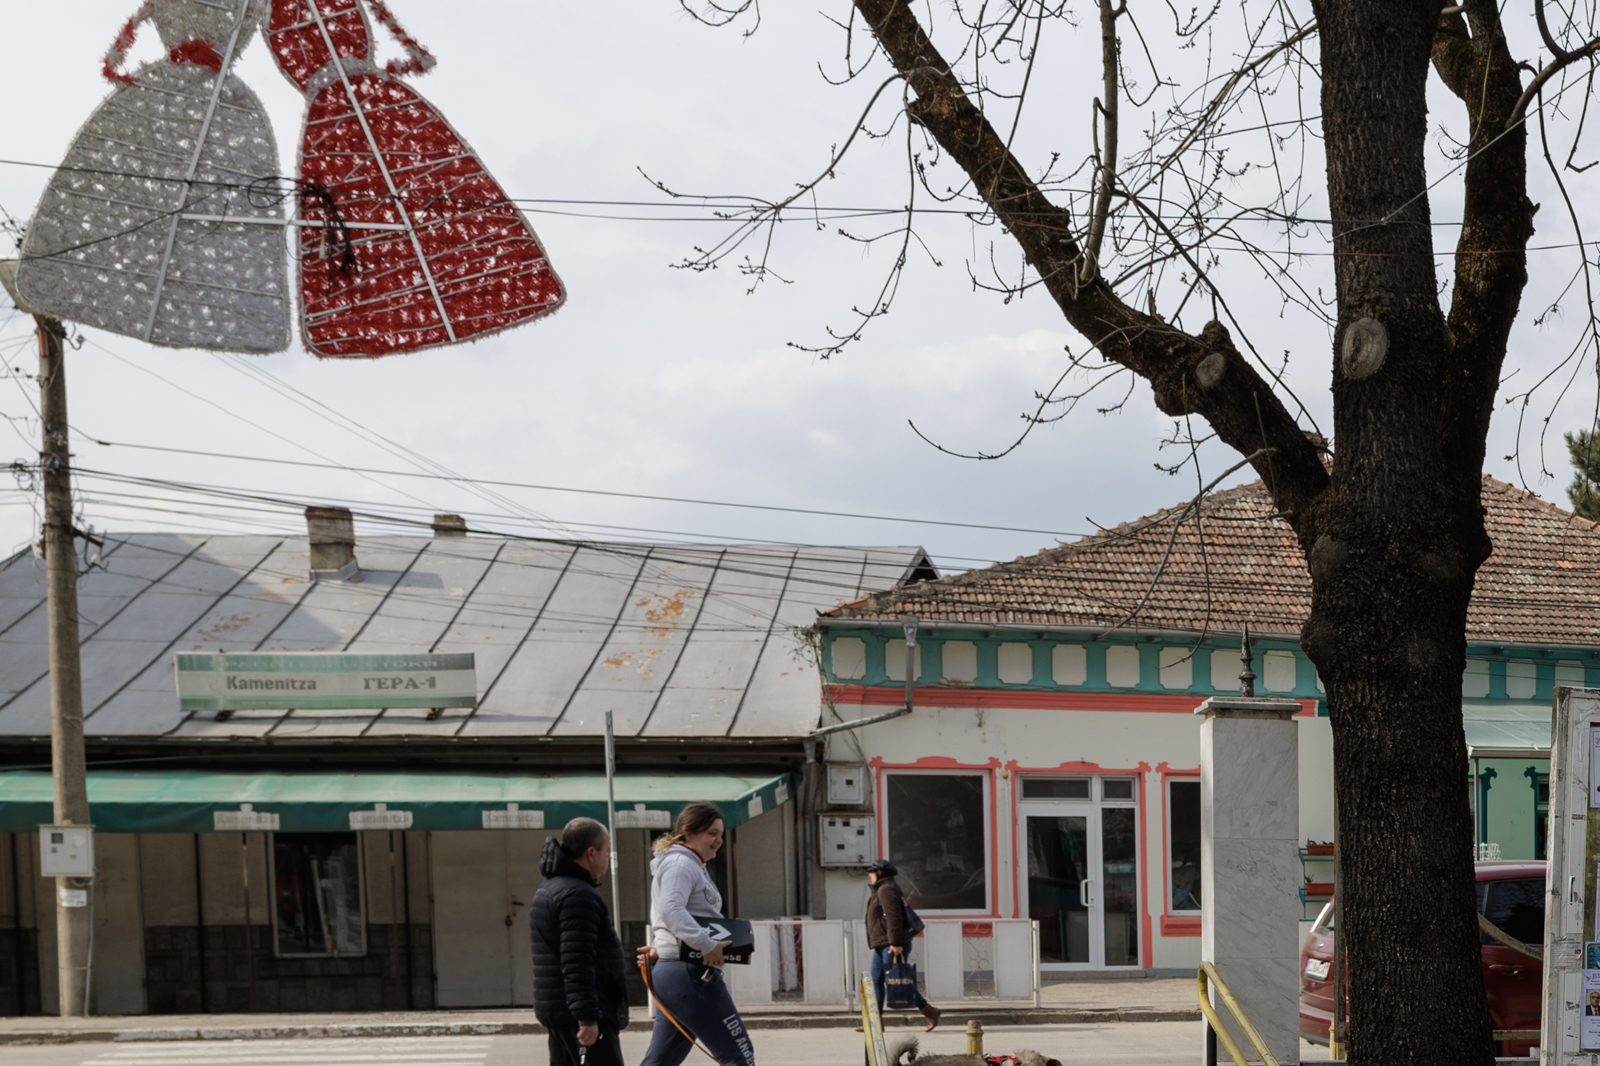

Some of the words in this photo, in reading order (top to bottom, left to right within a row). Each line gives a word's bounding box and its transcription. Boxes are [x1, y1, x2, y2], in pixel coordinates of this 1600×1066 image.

[364, 660, 438, 669] СТОКИ
[226, 675, 317, 691] Kamenitza
[362, 676, 437, 690] ГЕРА-1
[722, 1013, 743, 1037] LOS
